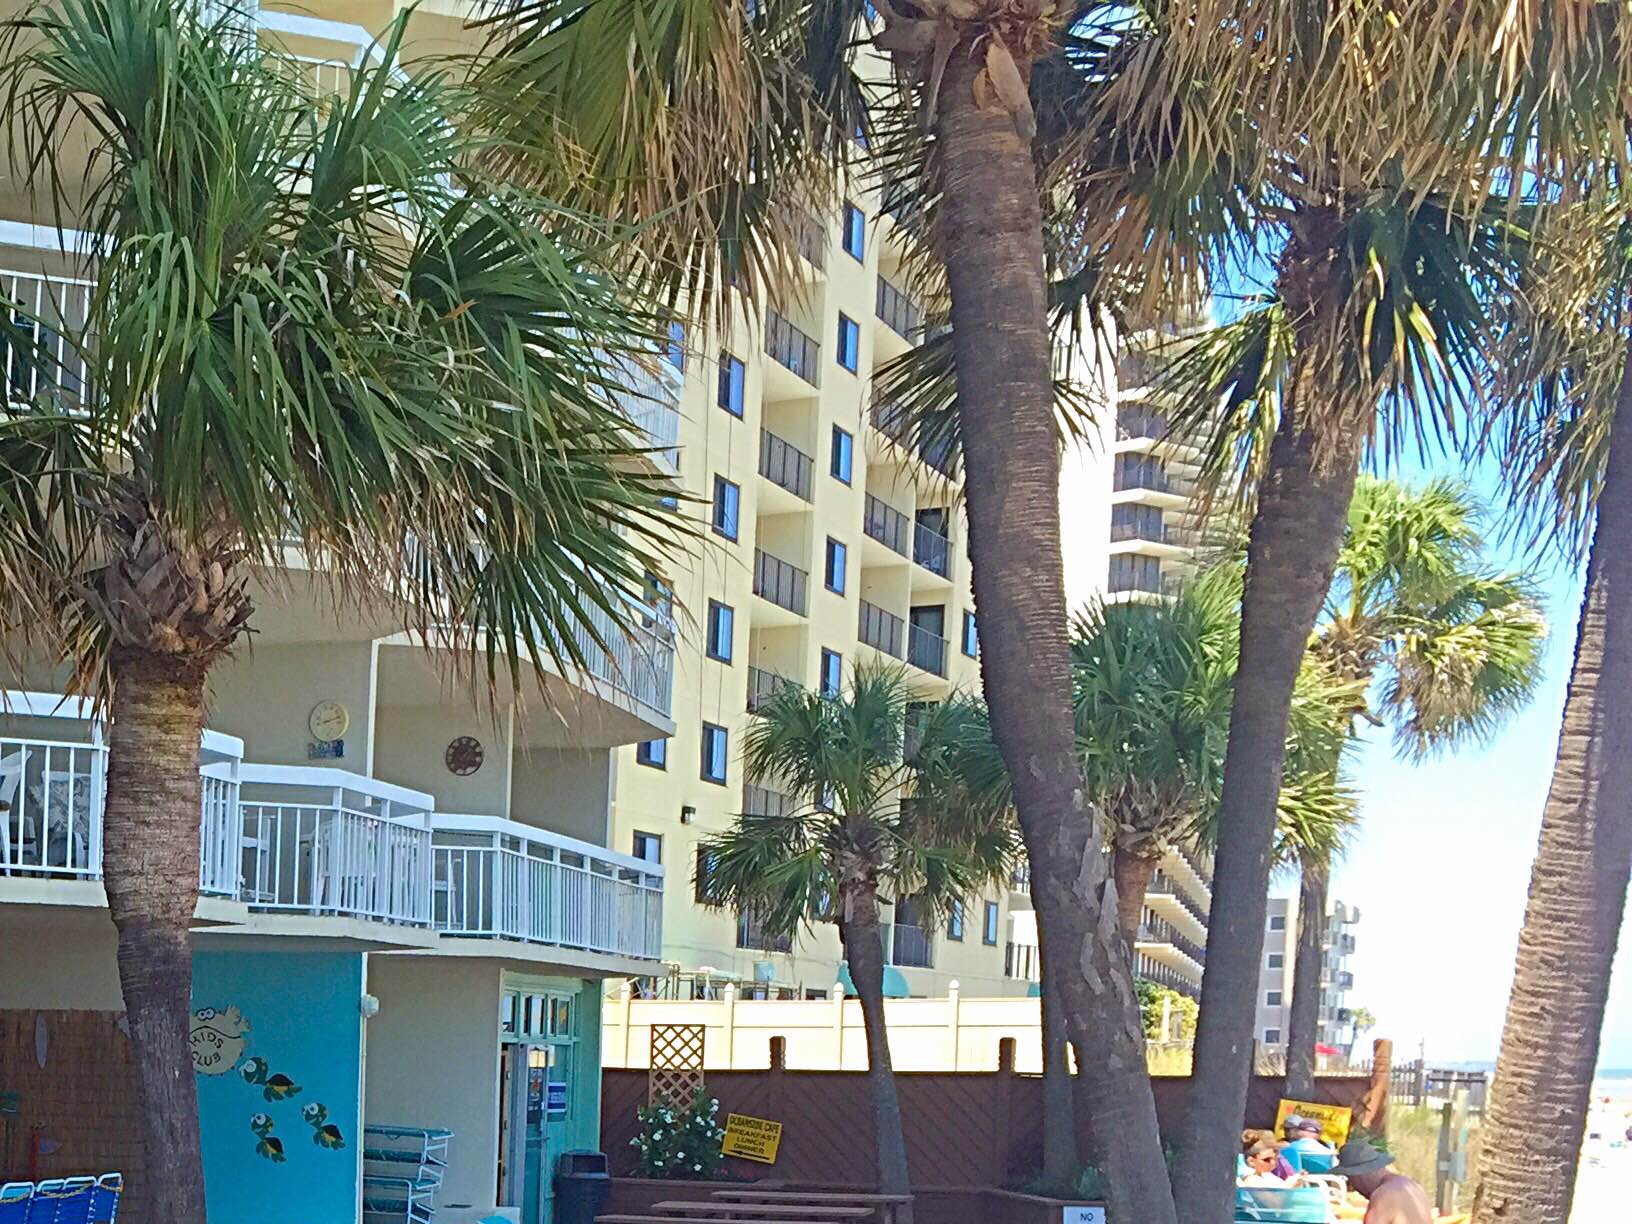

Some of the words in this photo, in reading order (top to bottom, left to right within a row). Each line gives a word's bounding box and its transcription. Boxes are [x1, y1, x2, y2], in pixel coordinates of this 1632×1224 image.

[188, 1032, 224, 1049] KIDS
[191, 1051, 222, 1067] CLUB
[1079, 1212, 1094, 1222] NO
